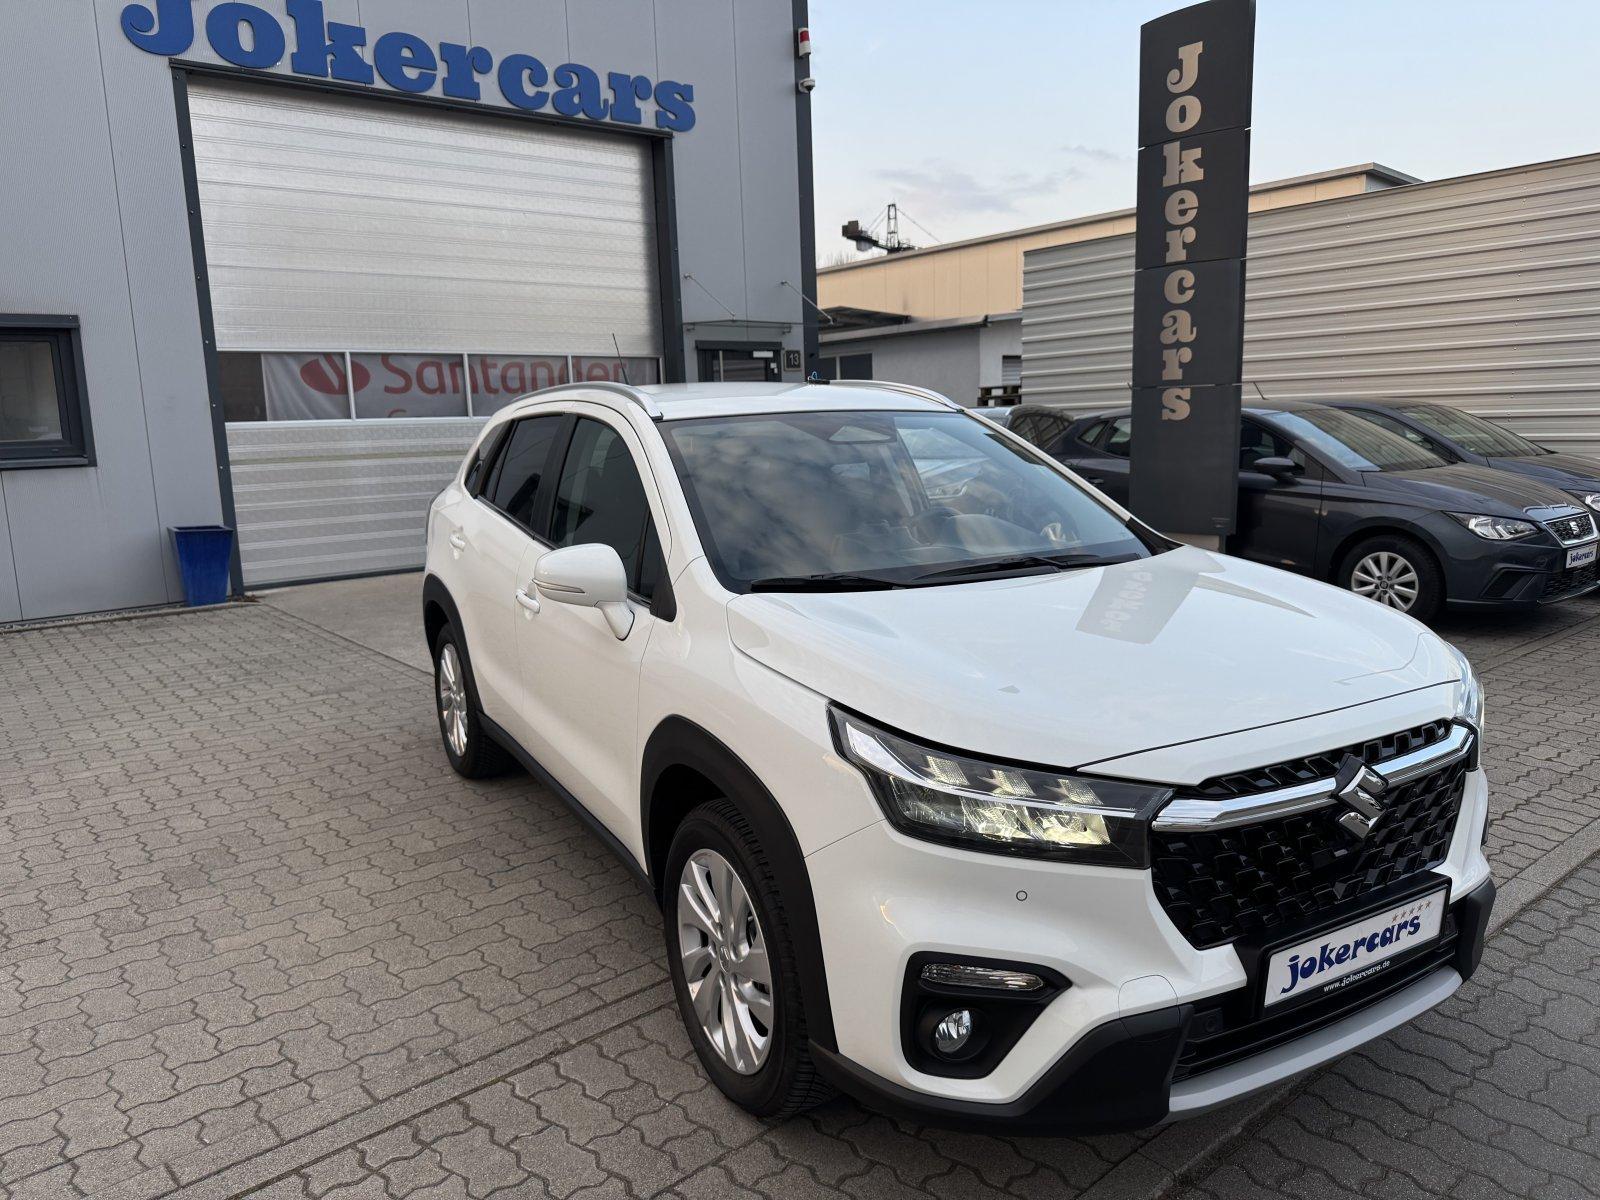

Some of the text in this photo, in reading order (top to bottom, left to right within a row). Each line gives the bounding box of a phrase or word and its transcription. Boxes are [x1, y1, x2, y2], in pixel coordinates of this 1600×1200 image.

[120, 0, 696, 133] Jokercars
[1160, 41, 1204, 421] Jokercars
[789, 354, 800, 366] 13
[1280, 914, 1421, 994] jokercars
[1323, 959, 1391, 992] www.jokercars.de
